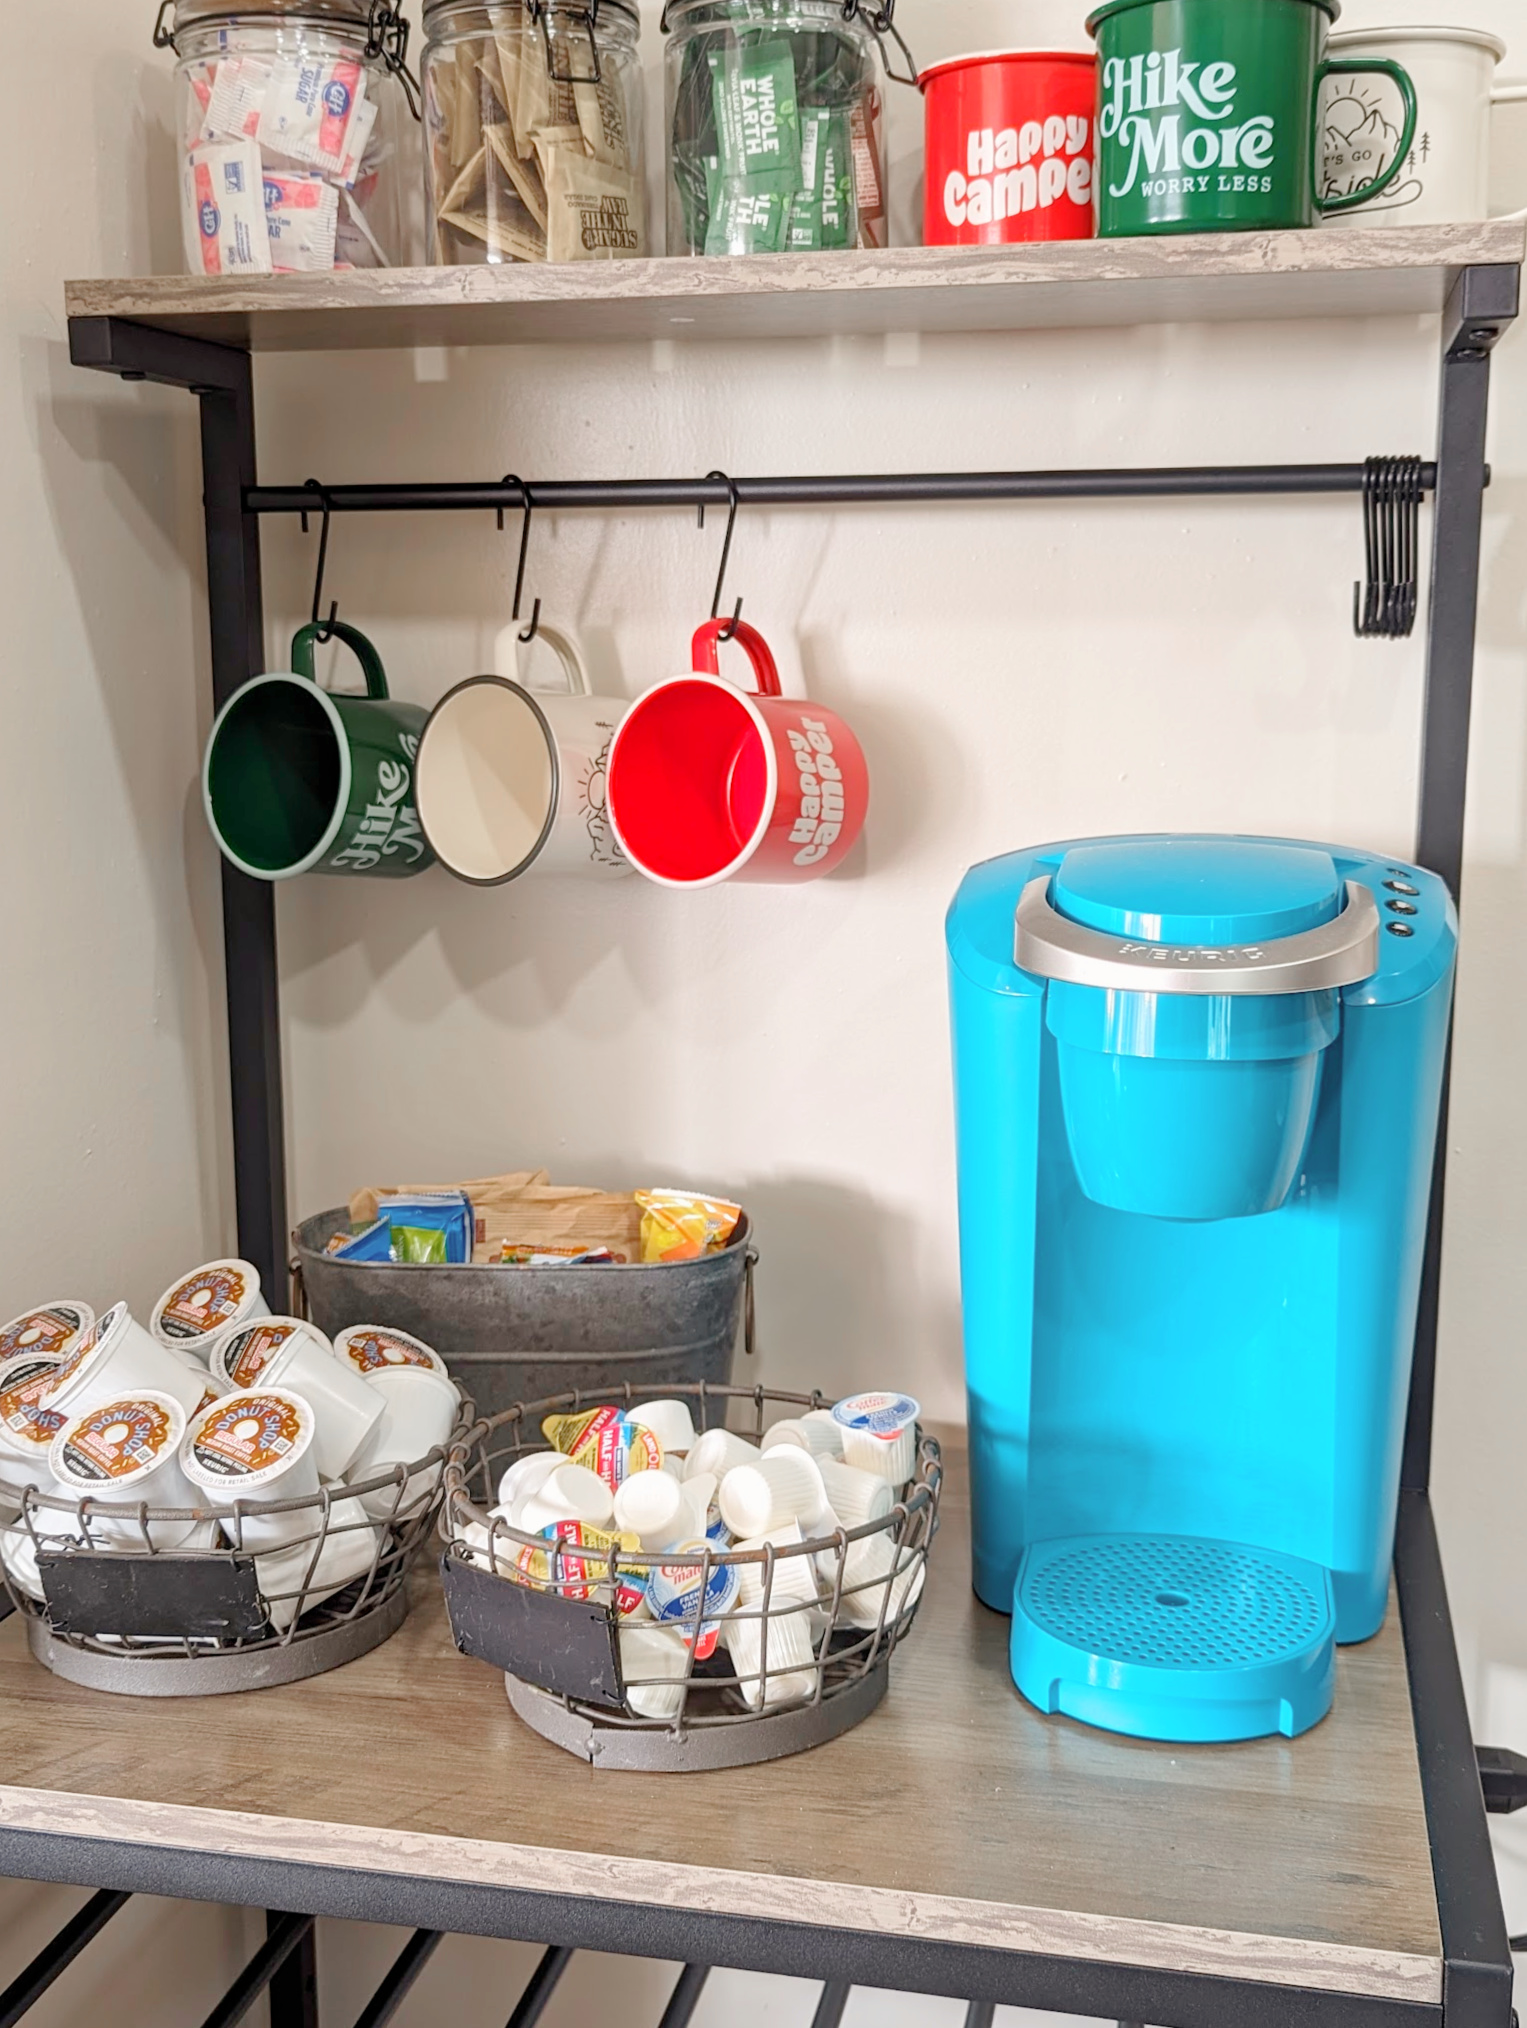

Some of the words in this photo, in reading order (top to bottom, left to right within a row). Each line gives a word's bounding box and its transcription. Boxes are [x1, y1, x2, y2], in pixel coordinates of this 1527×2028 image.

[296, 67, 314, 104] SUGAR
[1100, 48, 1237, 139] Hike
[732, 93, 741, 112] LEAF
[757, 74, 780, 153] WHOLE
[740, 78, 762, 155] EARTH
[735, 123, 744, 150] MONK
[967, 115, 1088, 177] Happy
[738, 152, 747, 176] FRUIT
[1108, 115, 1275, 198] More
[1352, 150, 1372, 163] GO
[943, 157, 1092, 227] Campe
[1141, 176, 1210, 198] WORRY
[1217, 175, 1272, 192] LESS
[600, 195, 629, 216] RAW
[581, 210, 611, 230] THE
[611, 213, 628, 231] IN
[592, 229, 638, 249] SUGAR
[787, 729, 821, 844] Happy
[793, 717, 844, 866] Camper
[330, 760, 410, 870] Hike
[1118, 944, 1266, 962] KEURIG
[179, 1276, 224, 1302] DONUT
[210, 1282, 229, 1313] SHOP
[20, 1404, 60, 1429] SHOP
[131, 1403, 163, 1427] ORIGINAL
[252, 1398, 292, 1418] ORIGINAL
[90, 1410, 146, 1432] DONUT
[123, 1422, 151, 1456] SHOP
[215, 1406, 270, 1430] DONUT
[260, 1415, 281, 1449] SHOP
[588, 1409, 611, 1436] HALF
[84, 1432, 120, 1460] REGULAR
[214, 1430, 256, 1454] REGULAR
[601, 1430, 614, 1461] HALF
[643, 1433, 658, 1454] LAND
[202, 1458, 229, 1474] KEURIG
[251, 1471, 267, 1481] SALE
[564, 1524, 578, 1545] ALF
[568, 1563, 585, 1599] HLF
[616, 1591, 635, 1609] LF
